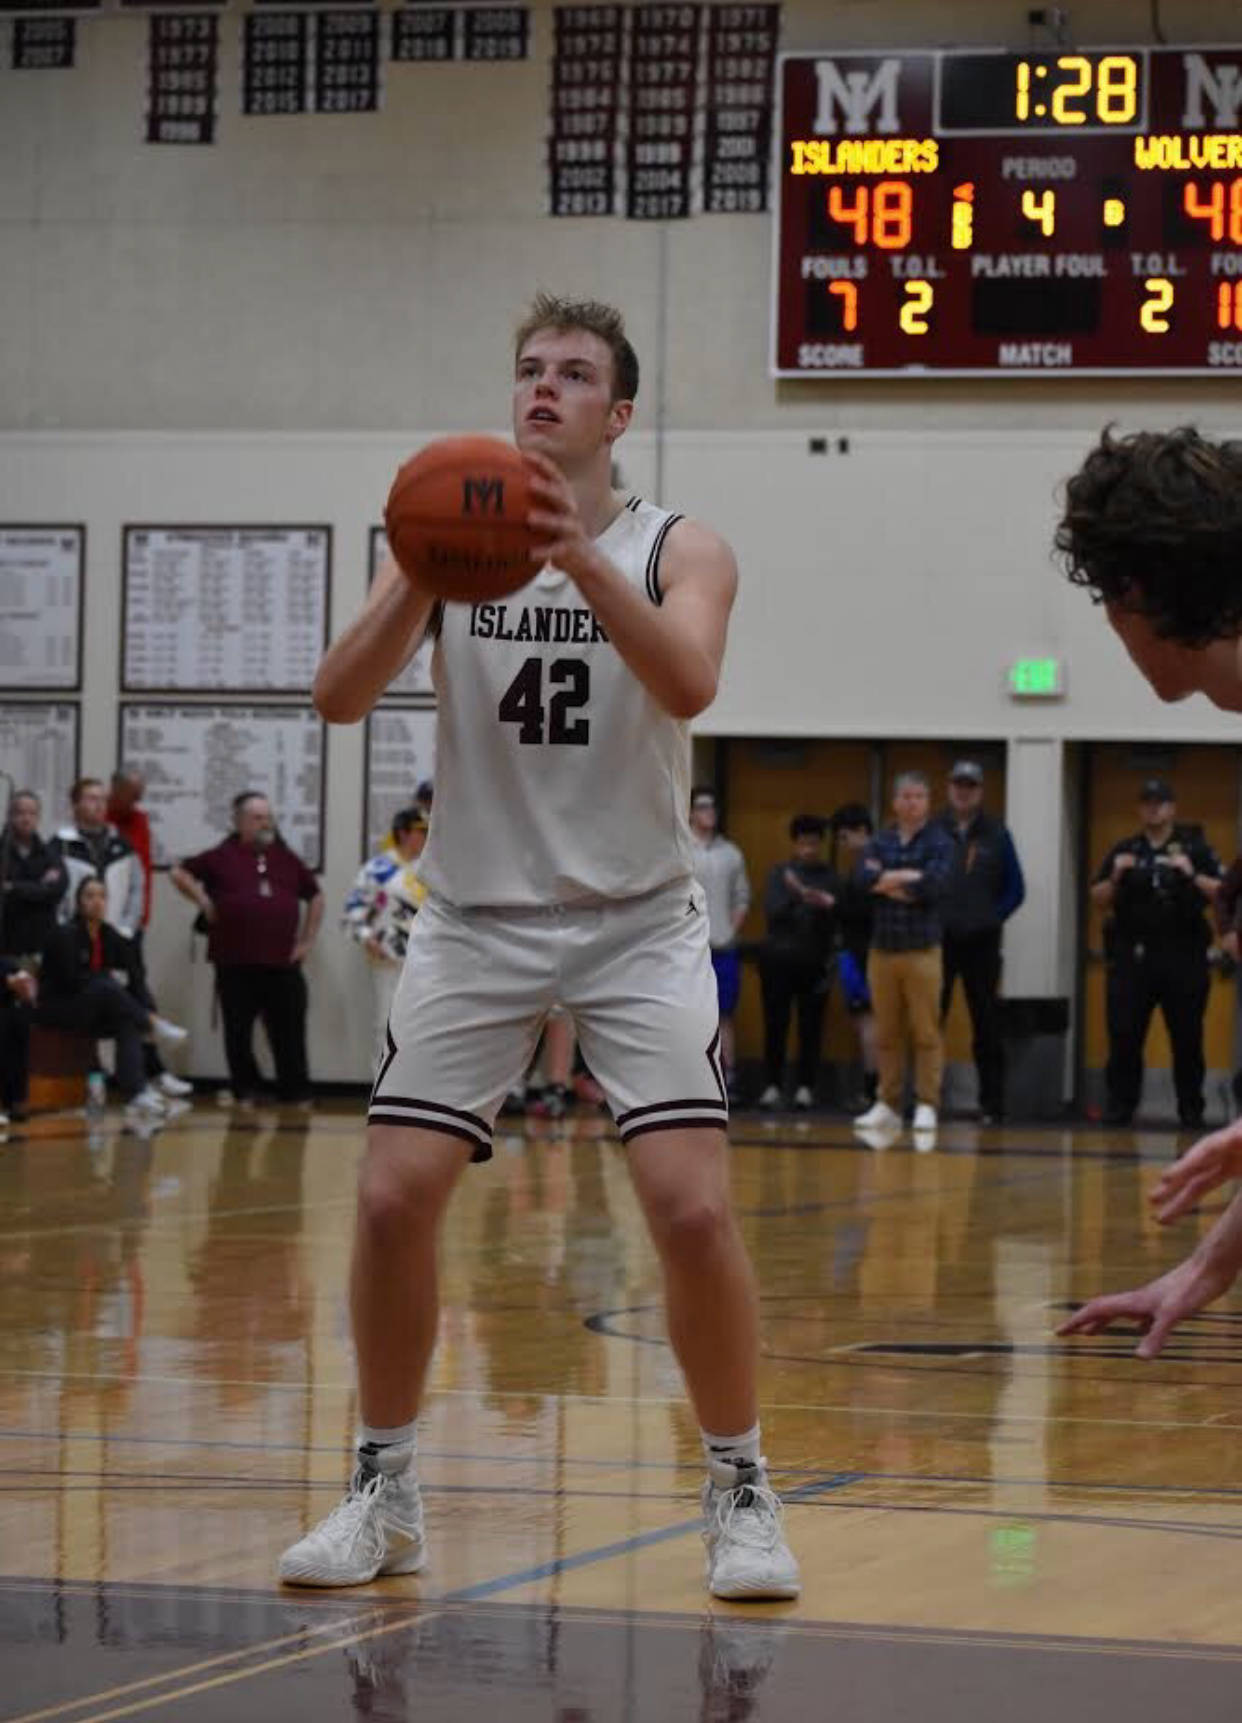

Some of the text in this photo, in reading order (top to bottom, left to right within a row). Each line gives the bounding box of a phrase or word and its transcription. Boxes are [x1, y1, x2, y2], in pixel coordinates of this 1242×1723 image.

[1016, 56, 1137, 124] 1:28
[791, 140, 939, 175] ISLANDERS
[1002, 157, 1077, 179] PERIOD
[1135, 135, 1242, 169] WOLVER
[829, 181, 912, 249] 48
[1022, 190, 1055, 237] 4
[801, 256, 867, 278] FOULS
[971, 255, 1107, 277] PLAYER FOUL
[828, 280, 858, 332] 7
[900, 280, 933, 335] 2
[1140, 278, 1174, 334] 2
[798, 343, 865, 367] SCORE
[999, 343, 1073, 366] MATCH
[499, 657, 590, 745] 42
